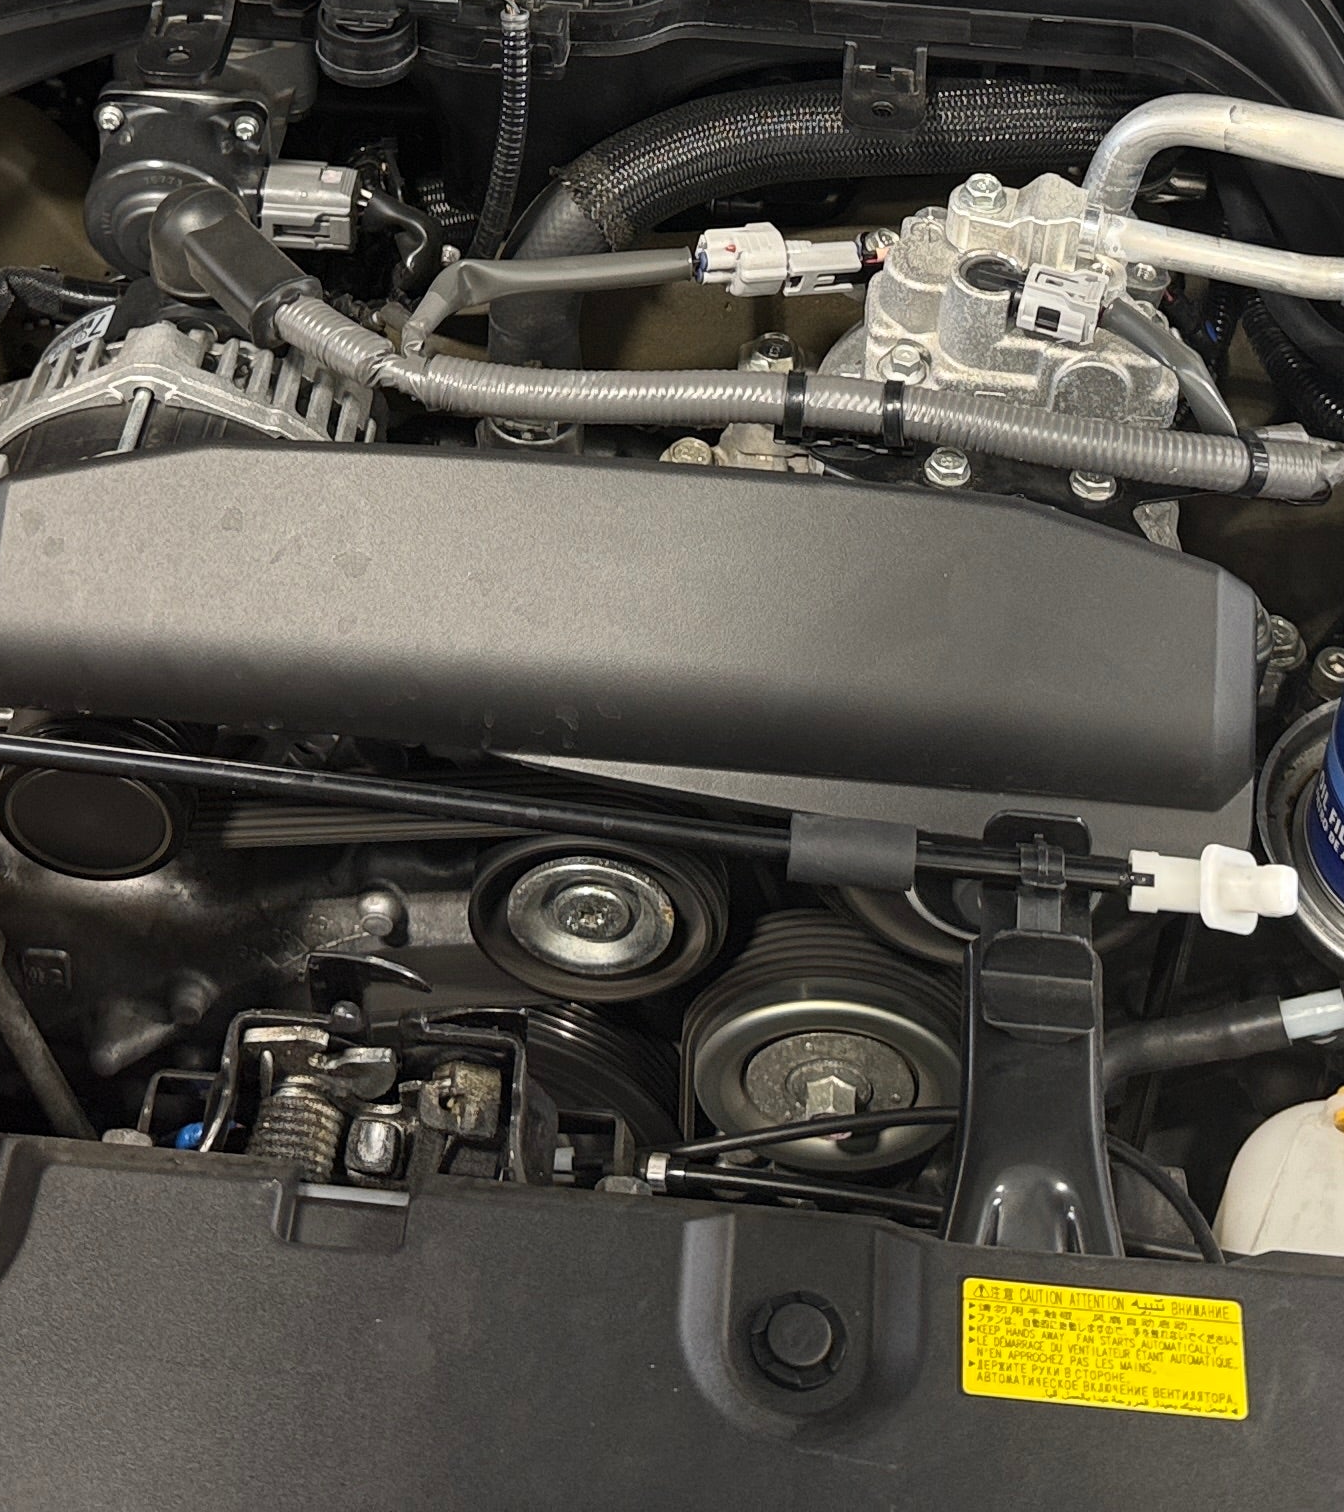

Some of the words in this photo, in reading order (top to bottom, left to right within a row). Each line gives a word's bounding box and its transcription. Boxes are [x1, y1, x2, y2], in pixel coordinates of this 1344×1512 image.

[1328, 831, 1340, 854] DE
[1019, 1287, 1062, 1305] CAUTION
[1069, 1292, 1124, 1311] ATTENTION
[1170, 1301, 1229, 1320] ВНИМАНИЕ
[976, 1324, 1000, 1335] KEEP
[1005, 1327, 1035, 1339] HANDS
[1076, 1333, 1094, 1344] FAN
[1099, 1335, 1136, 1348] STARTS
[1007, 1350, 1063, 1365] APPROCHEZ
[1069, 1355, 1089, 1367] PAS
[1095, 1358, 1114, 1370] LES
[1067, 1343, 1130, 1359] VENTILATEUR
[1031, 1363, 1060, 1376] РУКИ
[976, 1371, 1078, 1391] АВТОМАТИЧЕСКОЕ
